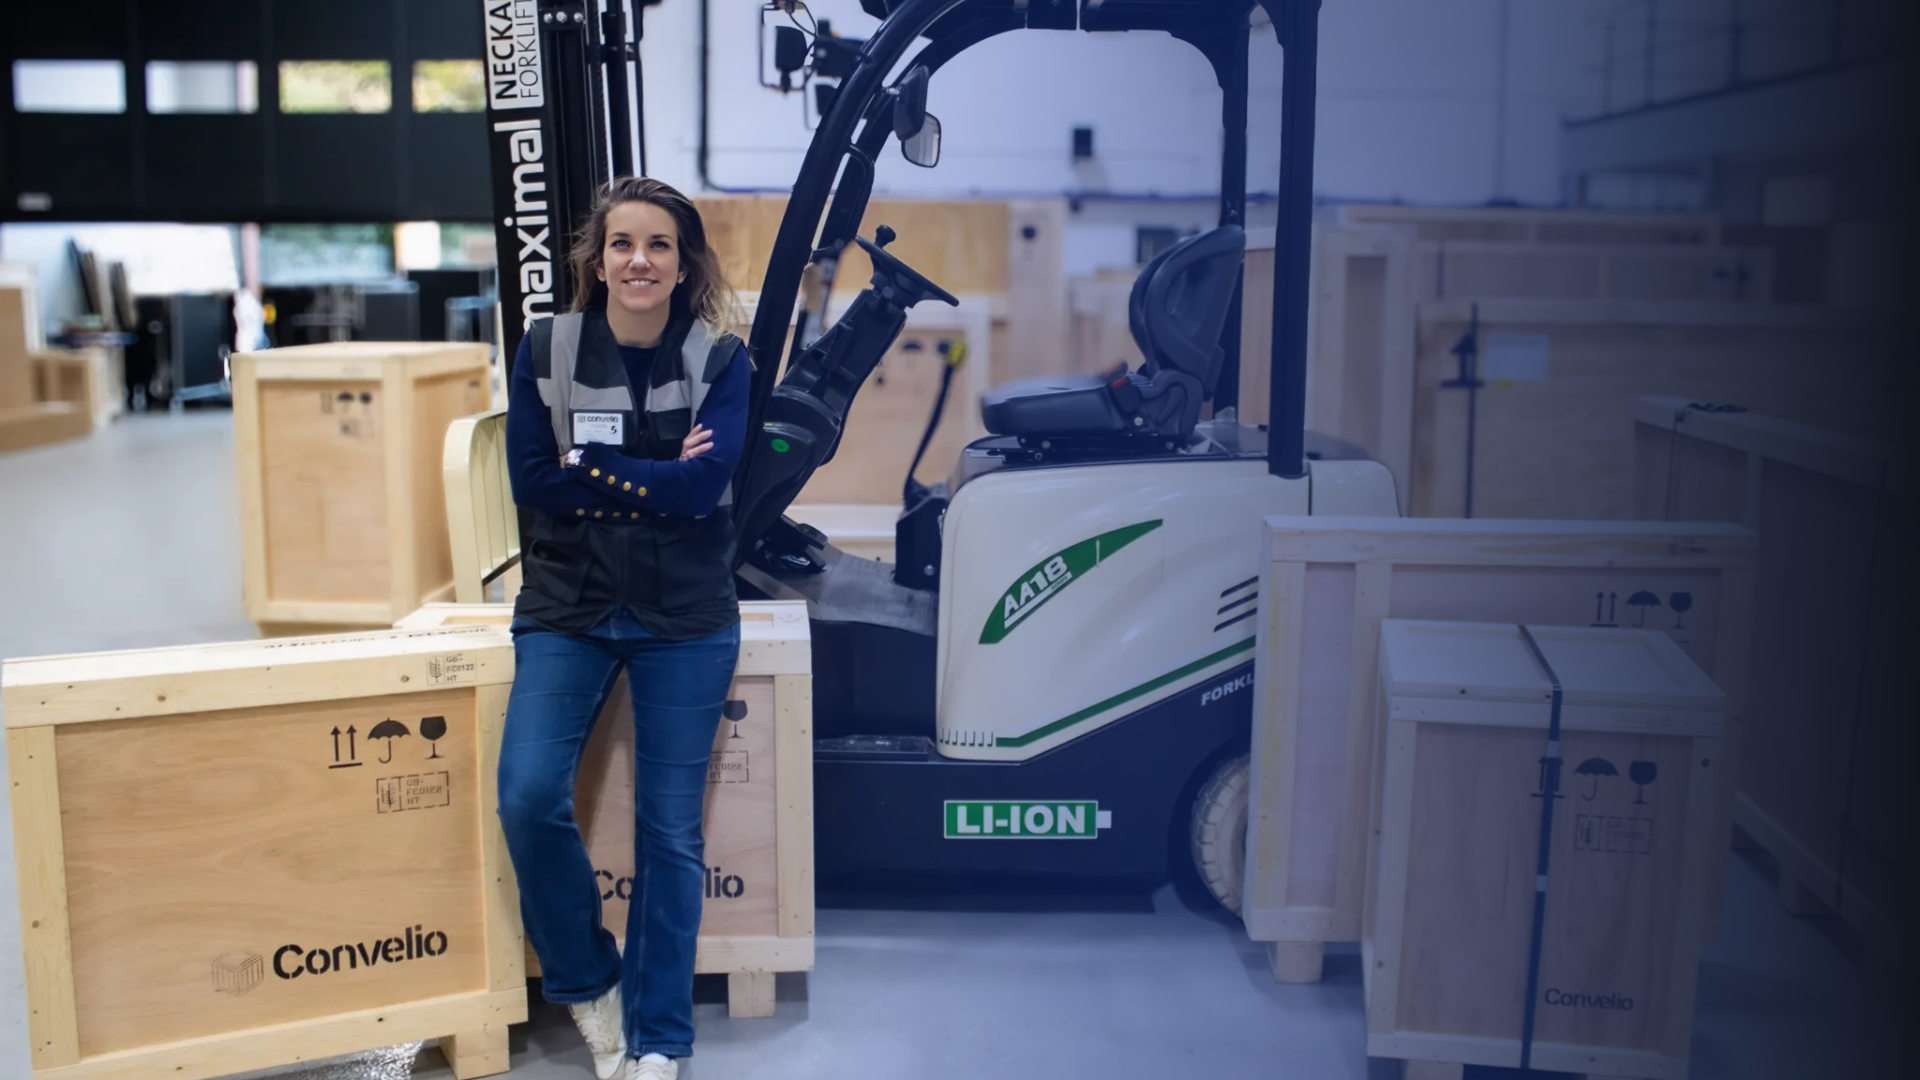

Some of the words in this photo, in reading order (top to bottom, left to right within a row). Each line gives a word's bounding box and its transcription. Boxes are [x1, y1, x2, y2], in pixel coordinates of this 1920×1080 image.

[489, 0, 518, 99] NECKA
[1003, 555, 1068, 620] AA18
[956, 804, 1086, 834] LI-ION
[594, 867, 745, 901] Colio
[272, 924, 448, 980] Convelio
[1544, 987, 1634, 1012] Convelio
